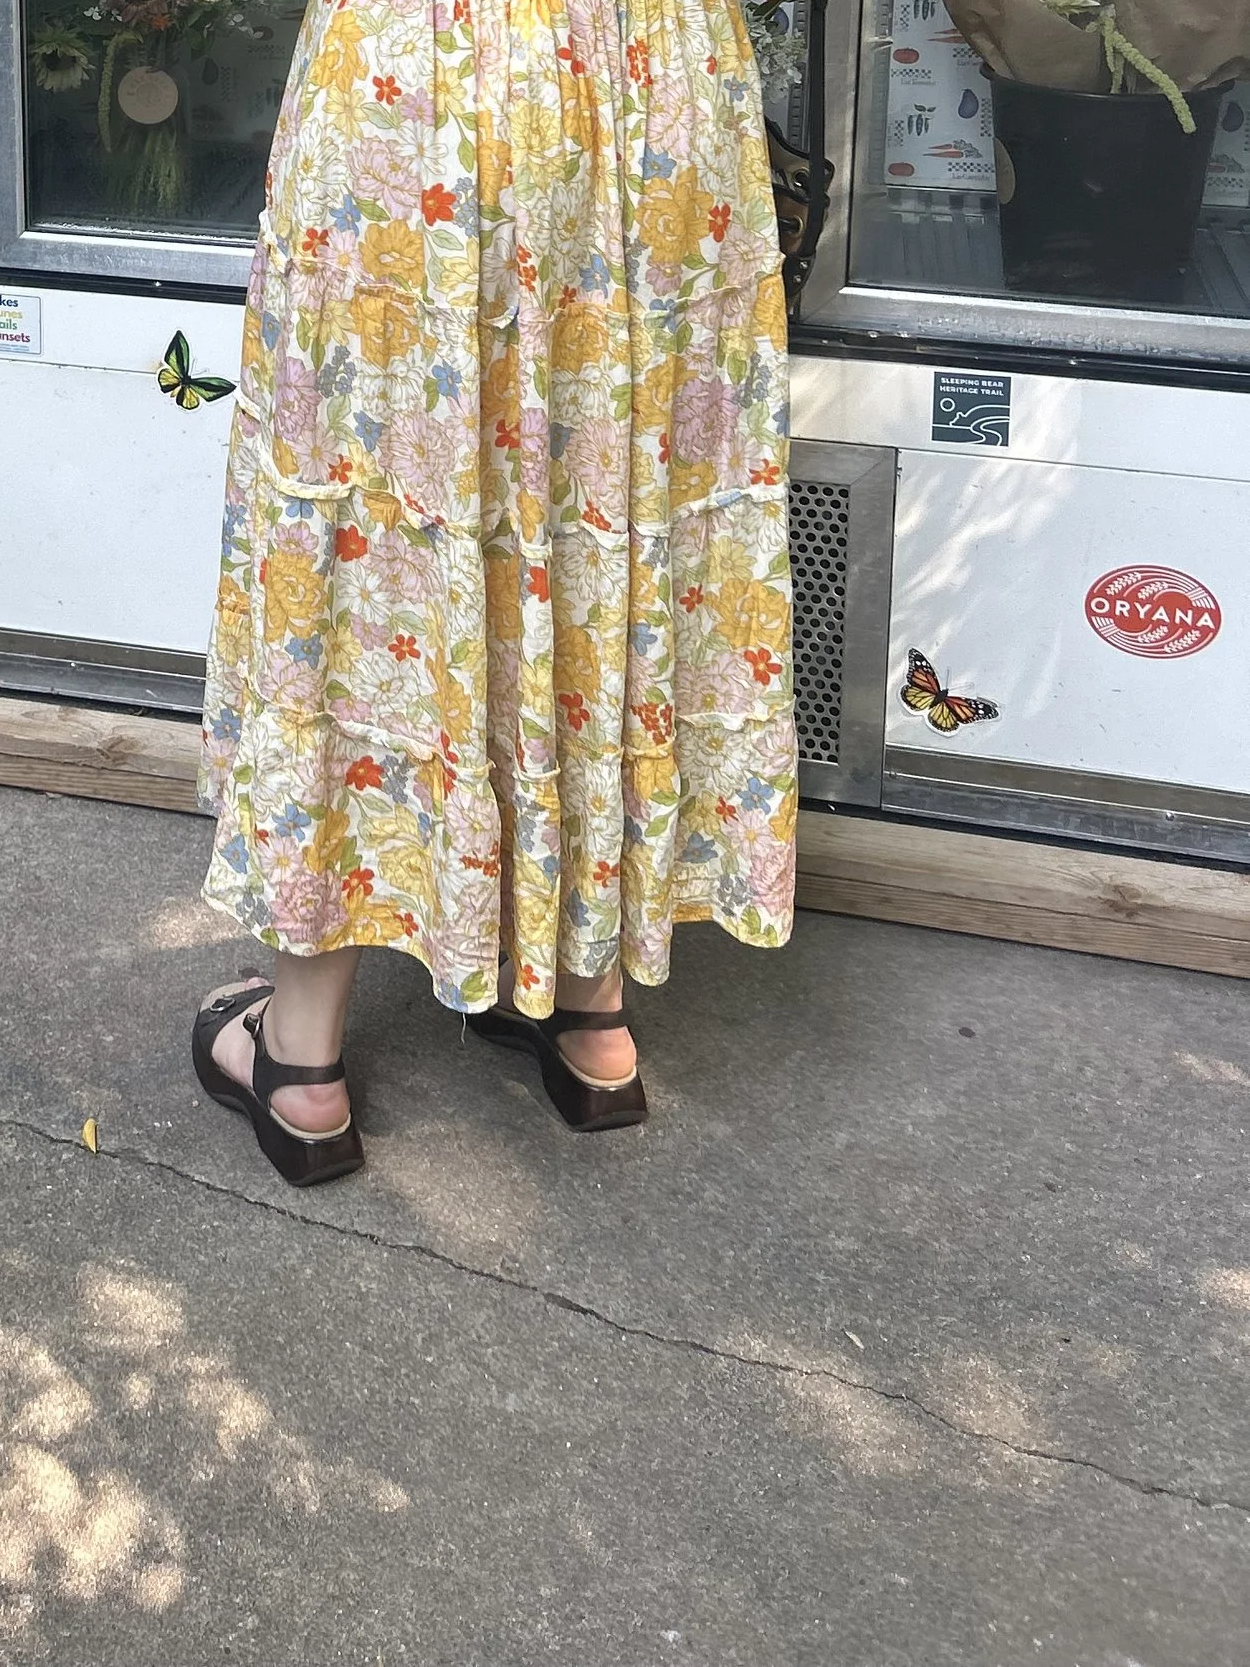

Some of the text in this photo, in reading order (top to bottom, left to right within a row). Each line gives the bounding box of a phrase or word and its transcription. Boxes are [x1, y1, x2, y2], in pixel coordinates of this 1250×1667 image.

[940, 377, 1004, 388] SLEEPING BEAR
[939, 385, 979, 394] HERITAGE
[1090, 597, 1216, 630] ORYANA
